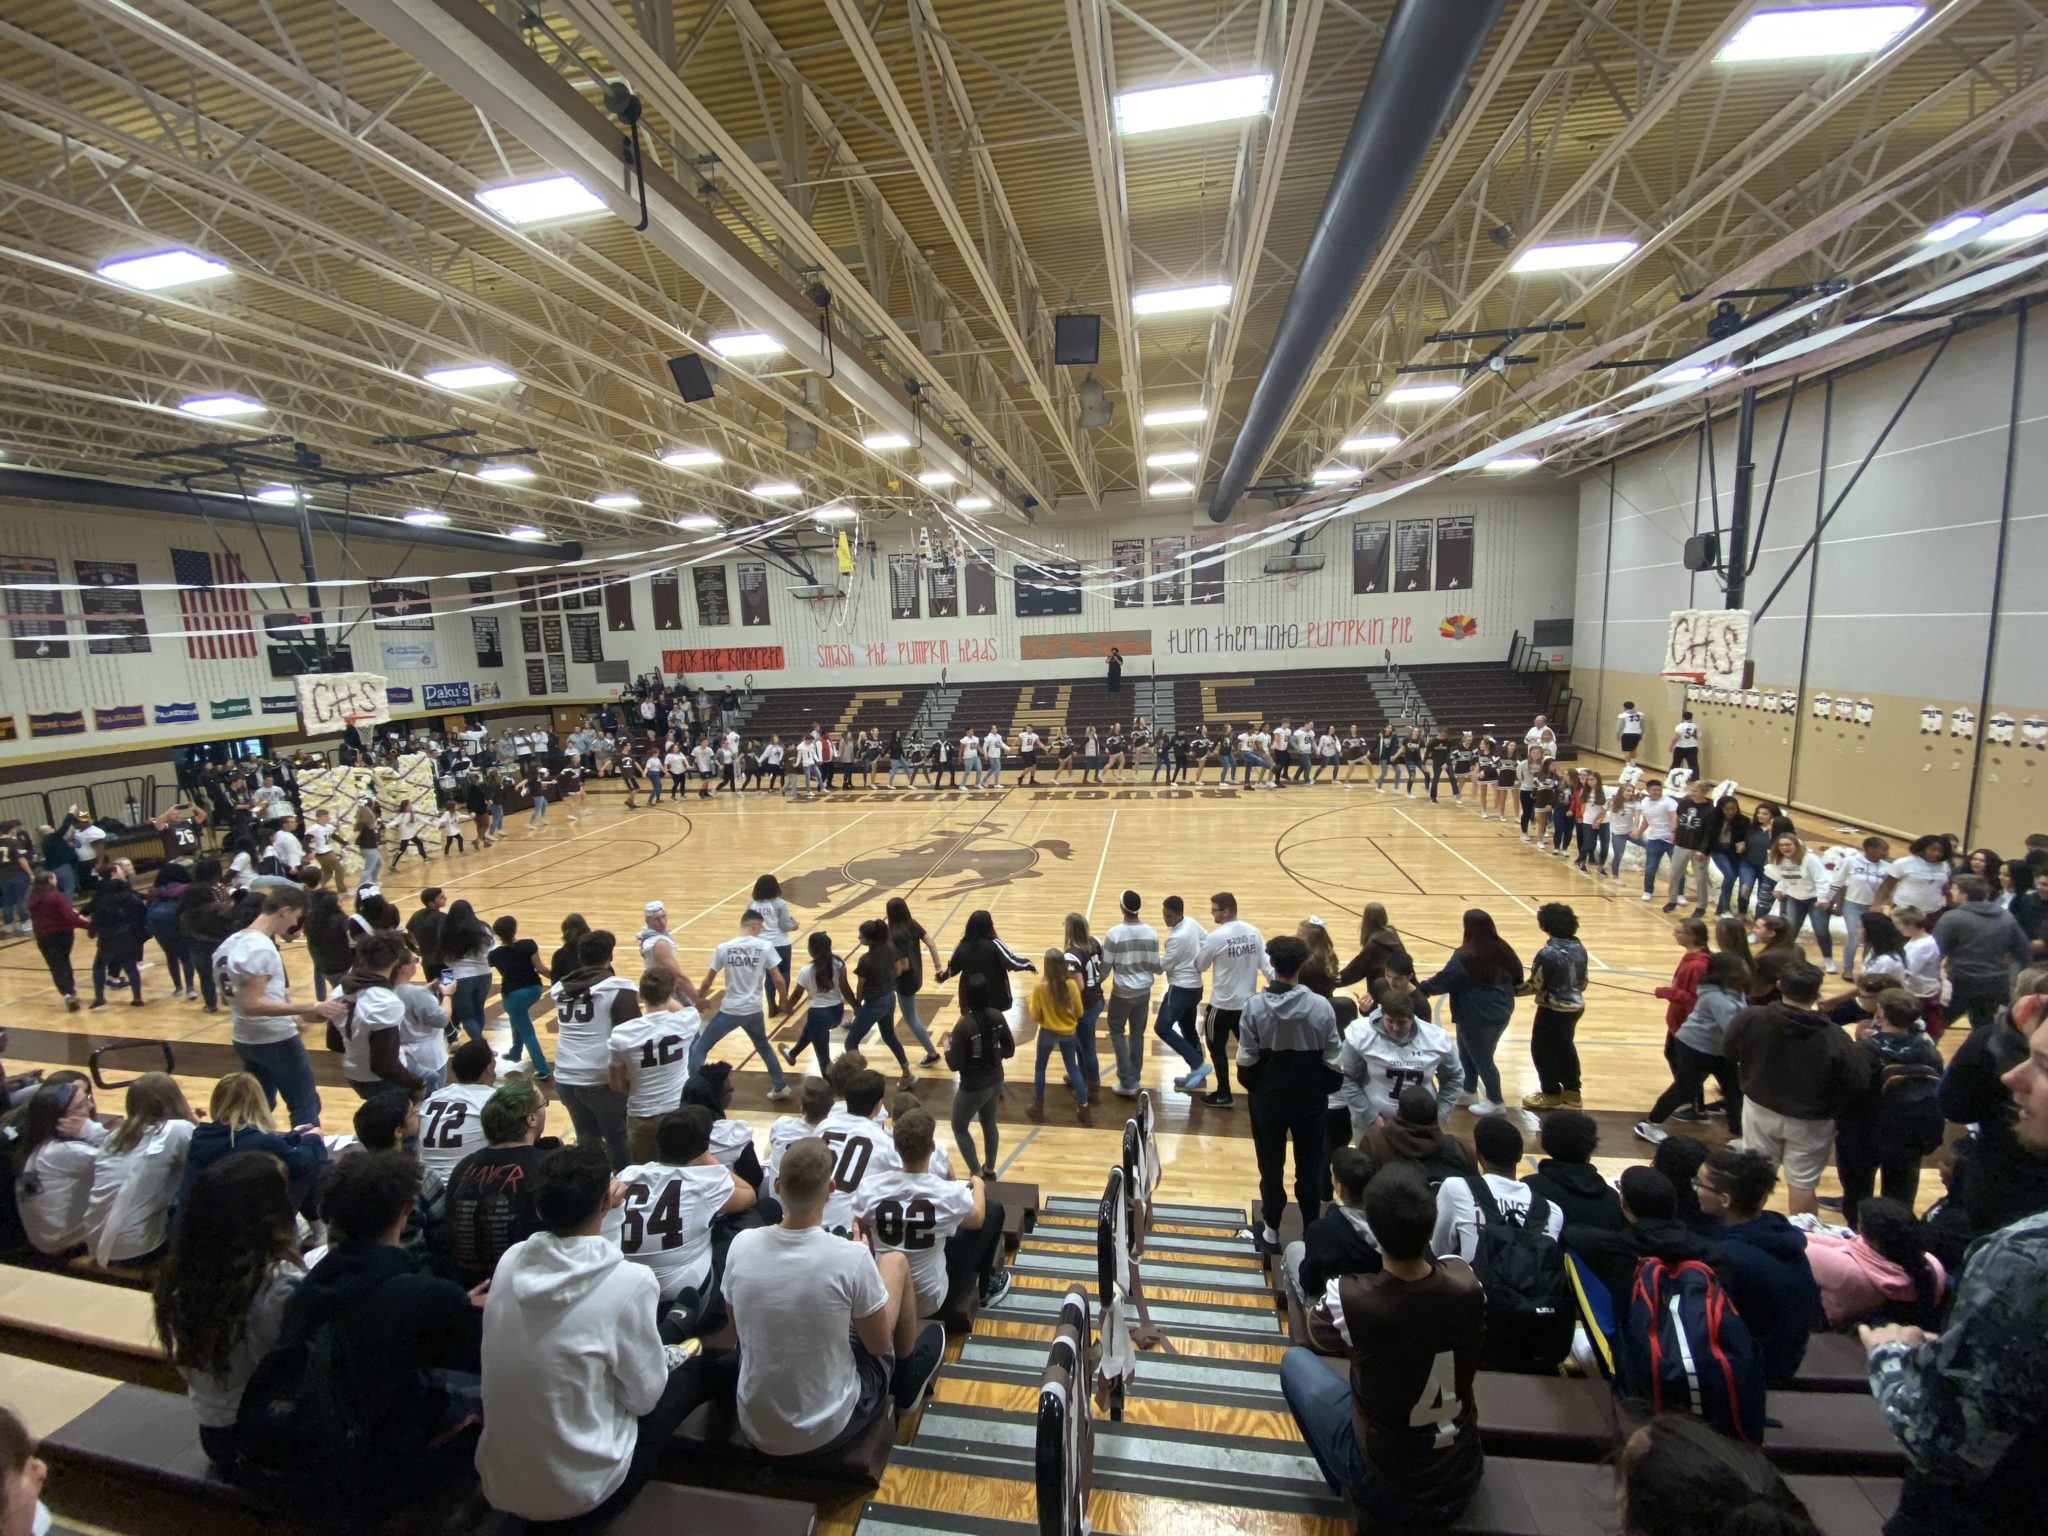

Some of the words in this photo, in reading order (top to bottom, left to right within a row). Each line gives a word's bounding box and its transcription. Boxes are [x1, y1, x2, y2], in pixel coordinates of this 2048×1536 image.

[1672, 617, 1739, 674] CHS
[312, 681, 377, 722] CHS
[424, 684, 469, 700] Daku's
[175, 829, 195, 846] 76
[726, 947, 752, 956] BRING
[754, 948, 763, 957] IT
[1226, 935, 1249, 946] BRING
[1228, 944, 1257, 958] HOME
[727, 956, 761, 967] HOME
[423, 1101, 468, 1148] 72
[621, 1179, 683, 1254] 64
[875, 1199, 936, 1250] 82
[1410, 1350, 1462, 1449] 4
